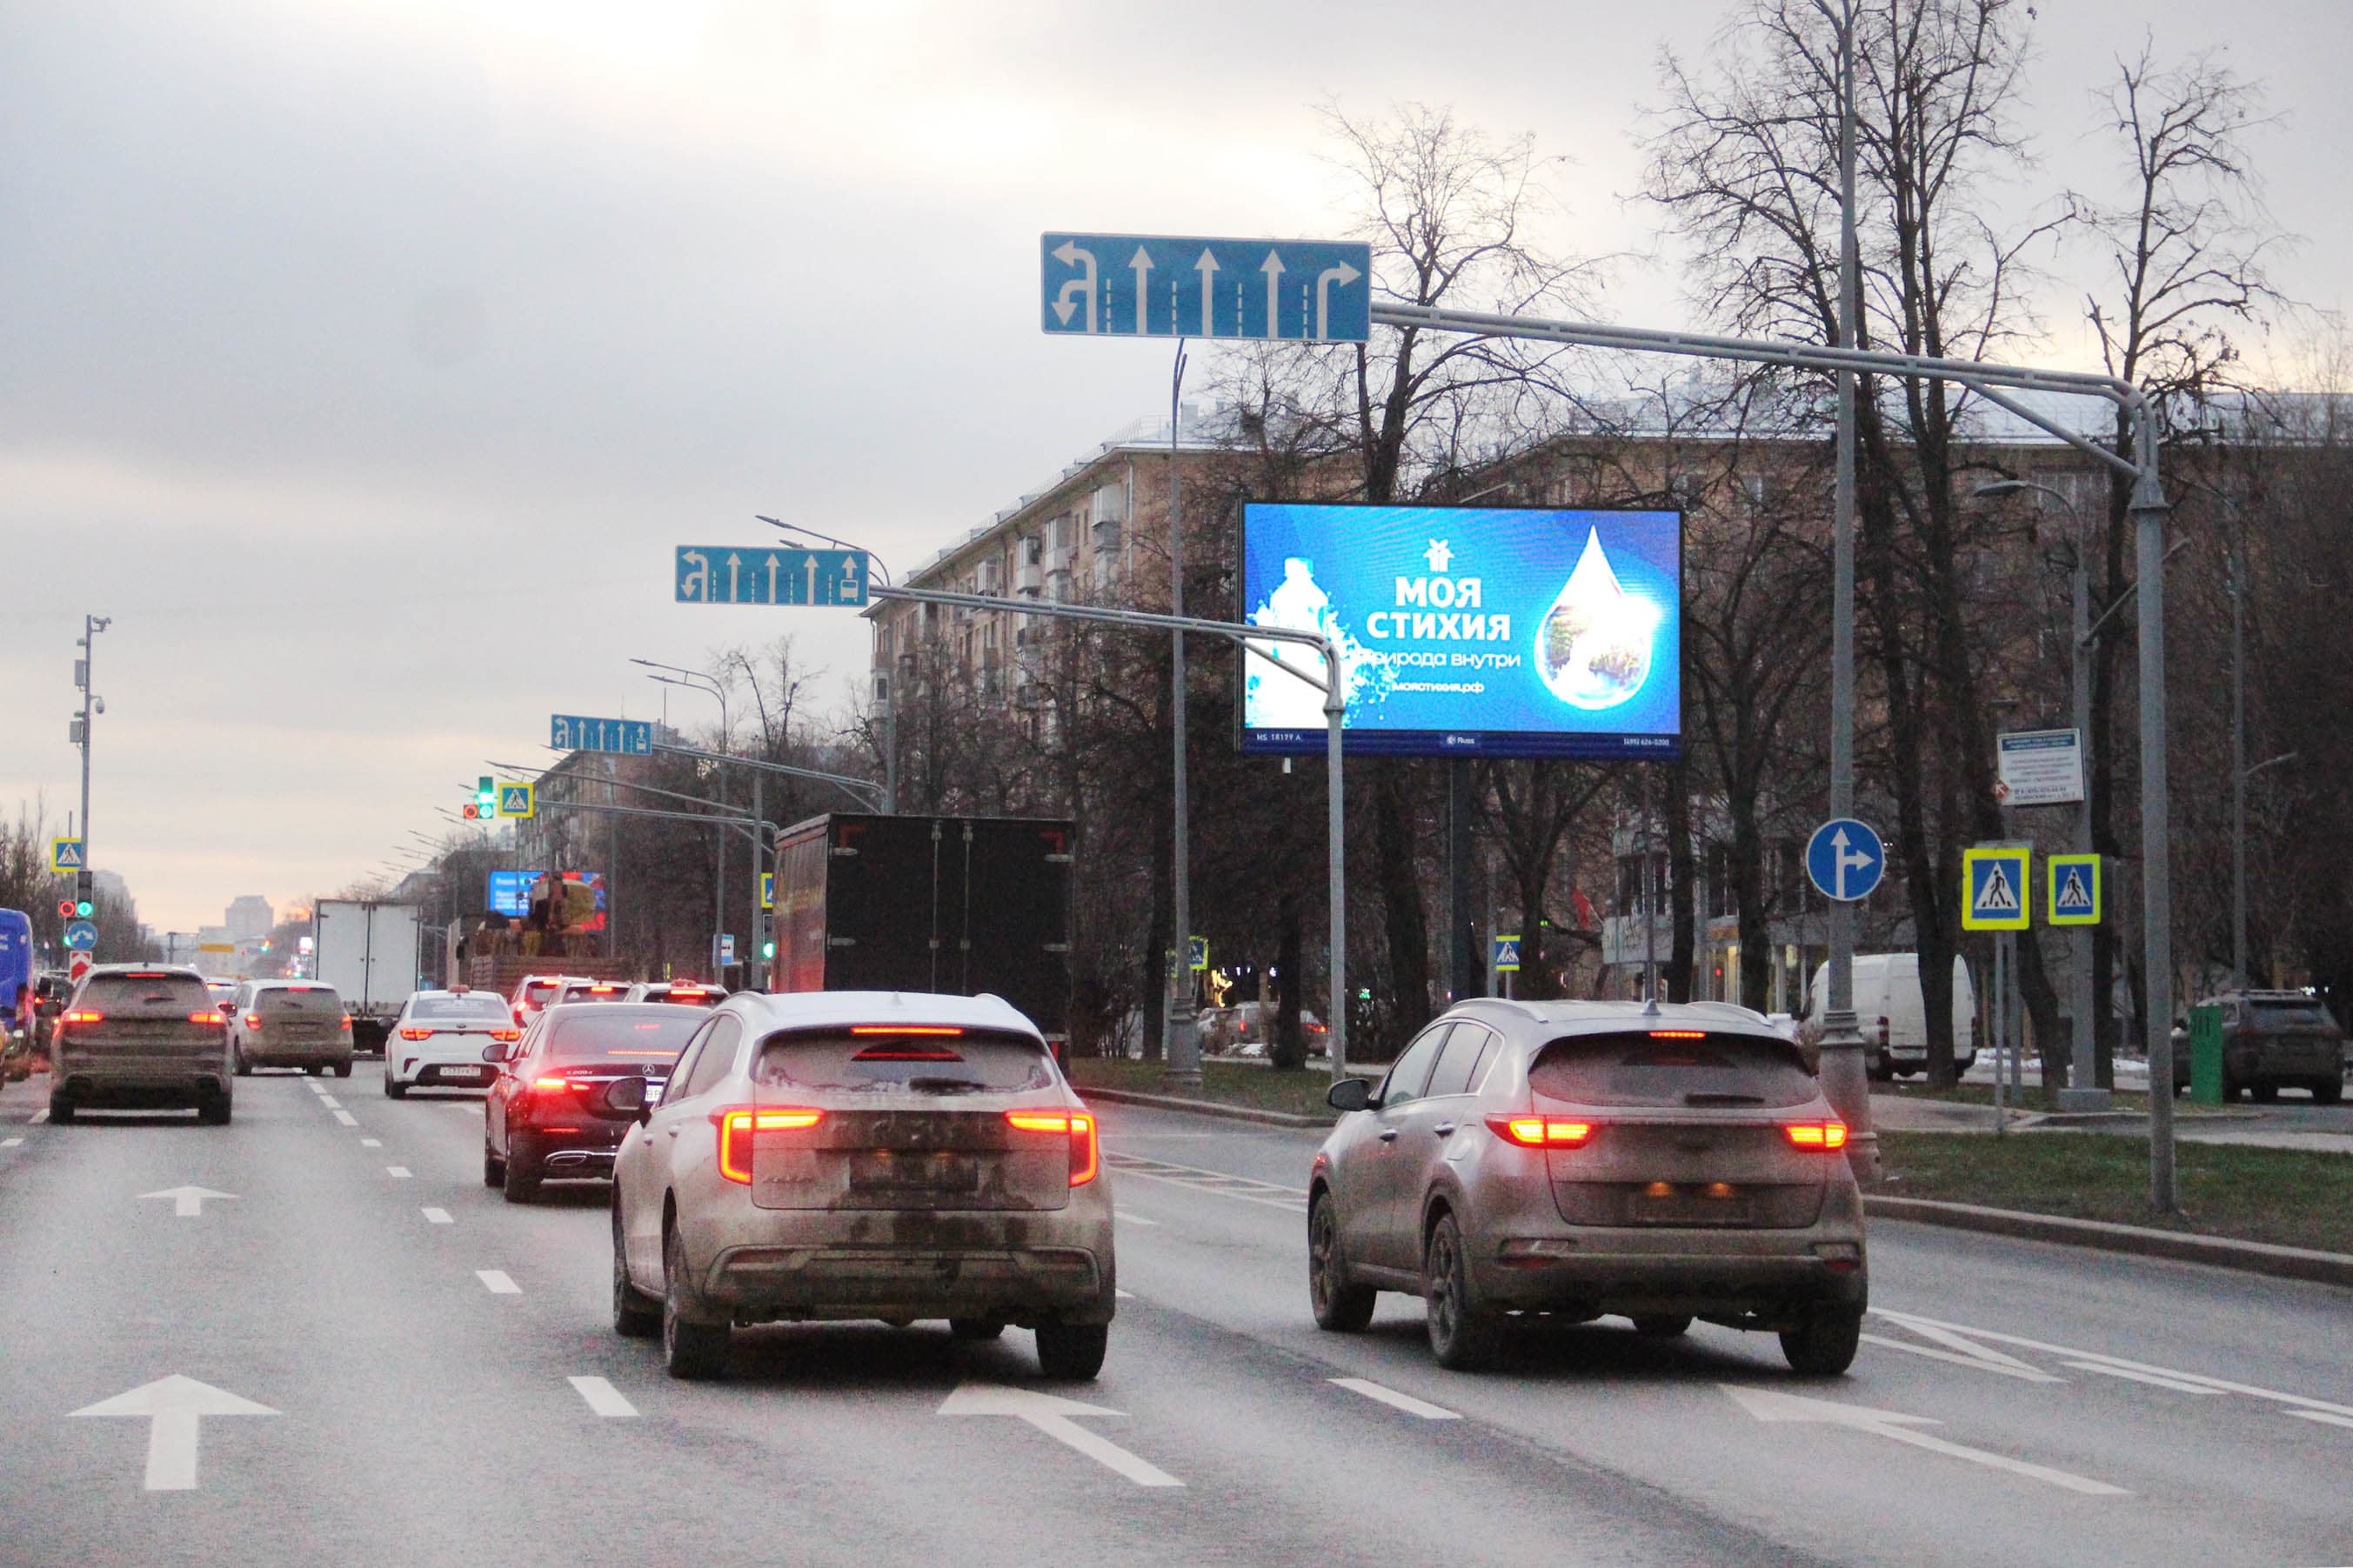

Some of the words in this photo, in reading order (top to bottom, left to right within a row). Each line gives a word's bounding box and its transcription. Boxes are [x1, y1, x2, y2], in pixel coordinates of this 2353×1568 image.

[1395, 577, 1481, 608] МОЯ
[1367, 611, 1510, 641] СТИХИЯ
[1451, 653, 1521, 670] внутри
